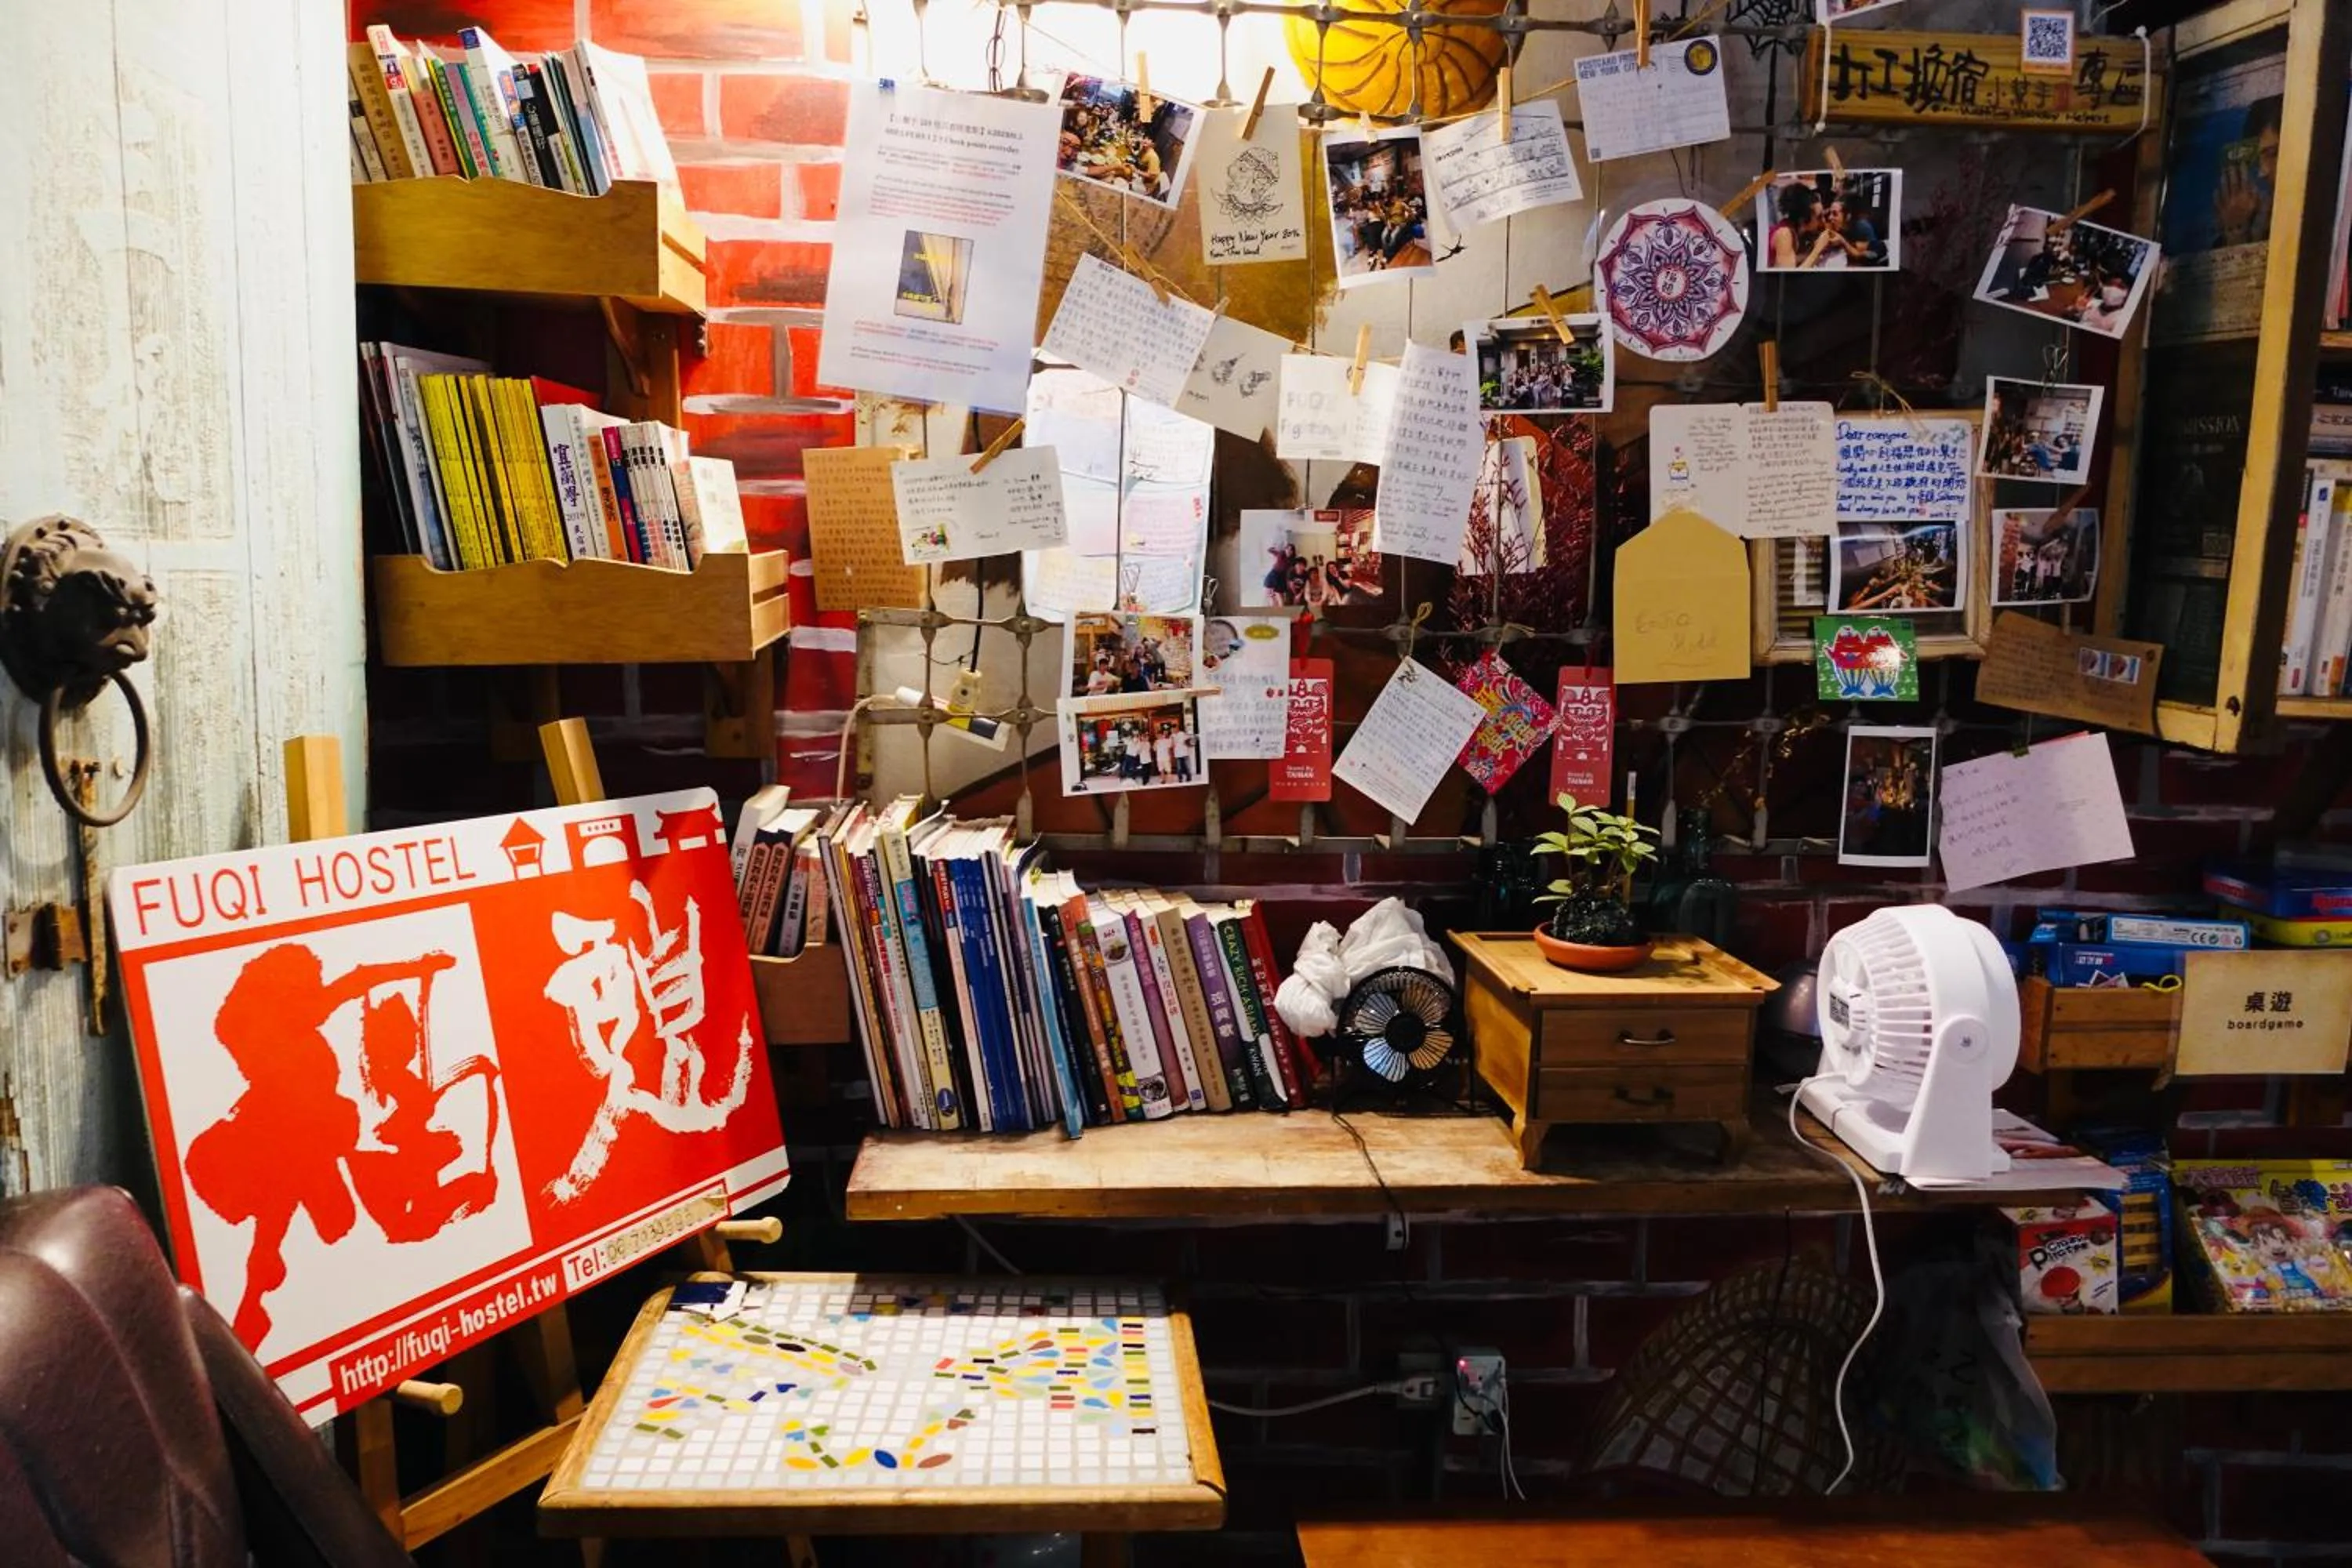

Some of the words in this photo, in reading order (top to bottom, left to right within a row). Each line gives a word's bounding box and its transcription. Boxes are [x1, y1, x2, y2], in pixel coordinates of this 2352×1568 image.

[132, 864, 267, 936] FUQI
[295, 835, 477, 908] HOSTEL
[1223, 924, 1241, 961] CRAZY
[1232, 964, 1249, 995] RICH
[2227, 1018, 2303, 1031] boardgame
[2245, 990, 2292, 1014] 桌遊
[568, 1247, 607, 1283] Tel:
[339, 1272, 557, 1396] http://fuqi-hostel.tw
